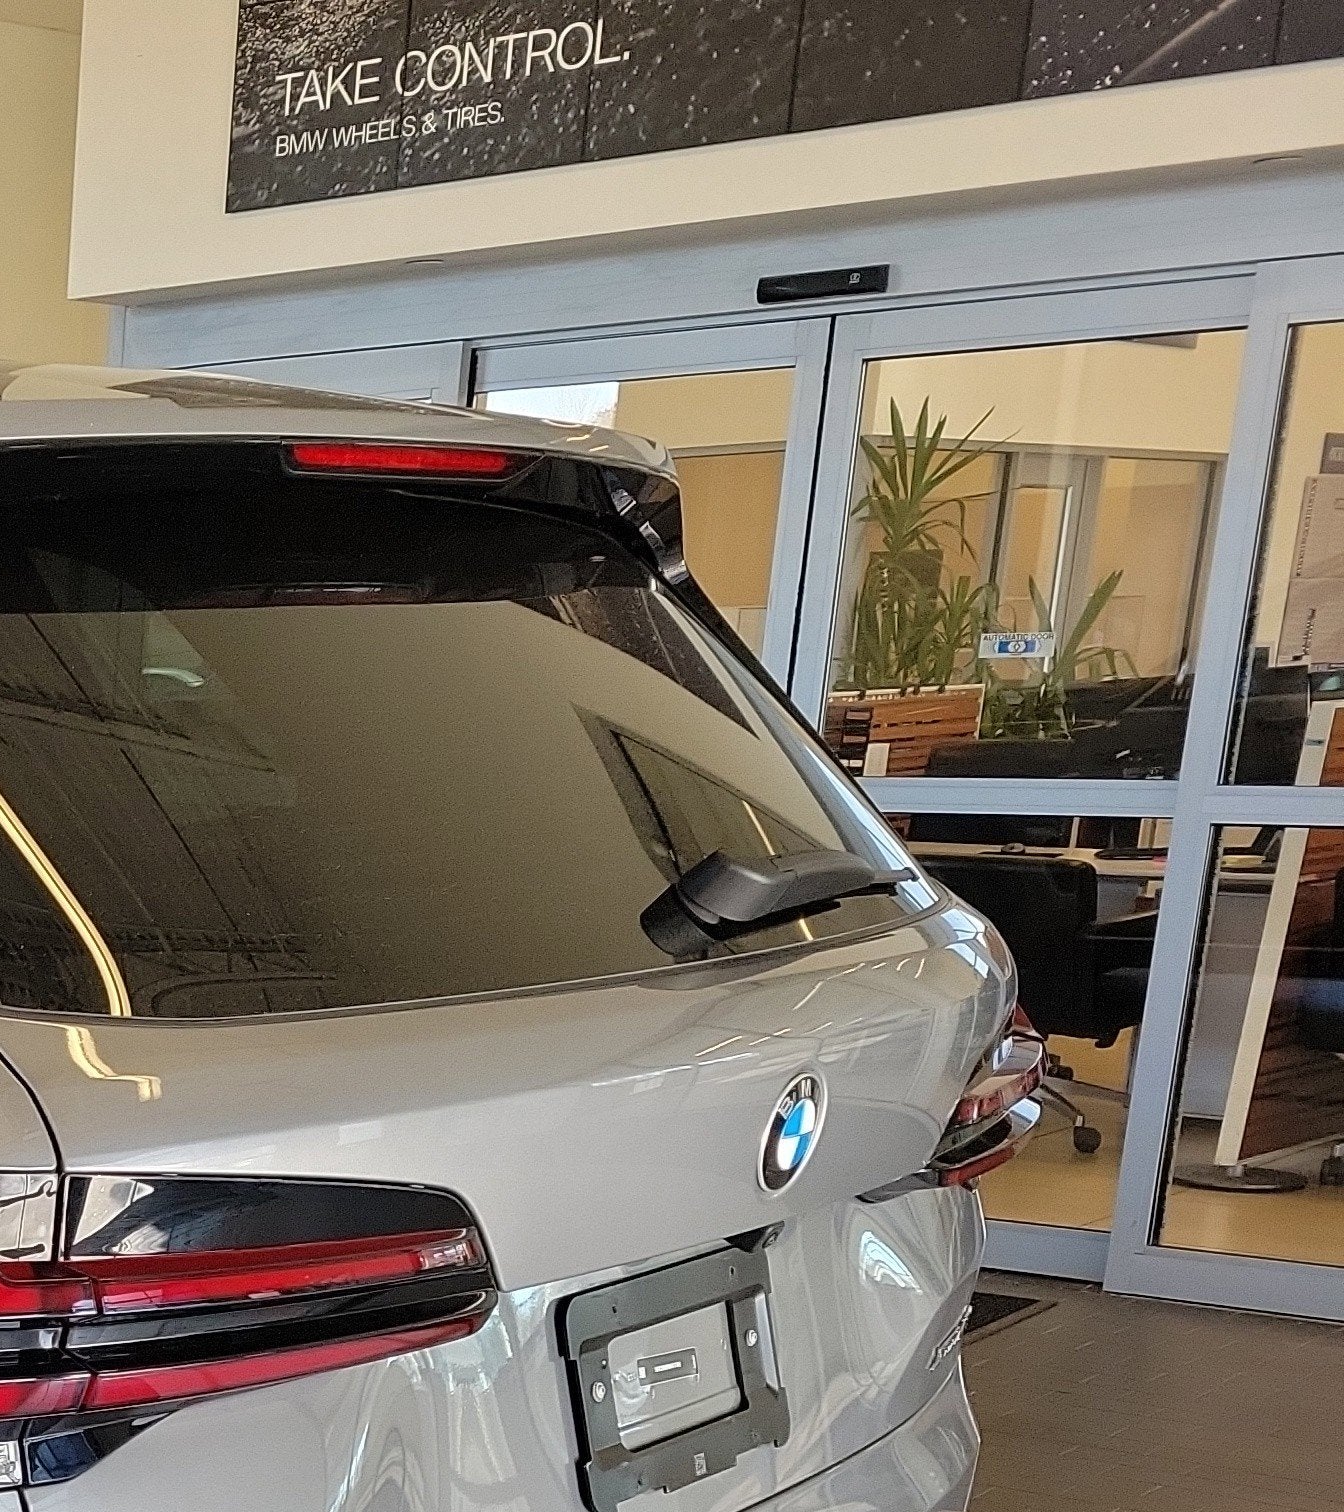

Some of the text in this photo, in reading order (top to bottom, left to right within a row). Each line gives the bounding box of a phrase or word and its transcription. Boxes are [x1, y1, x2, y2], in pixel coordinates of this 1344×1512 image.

[275, 18, 631, 118] TAKE CONTROL.
[275, 101, 505, 157] BMW WHEELS & TIRES.
